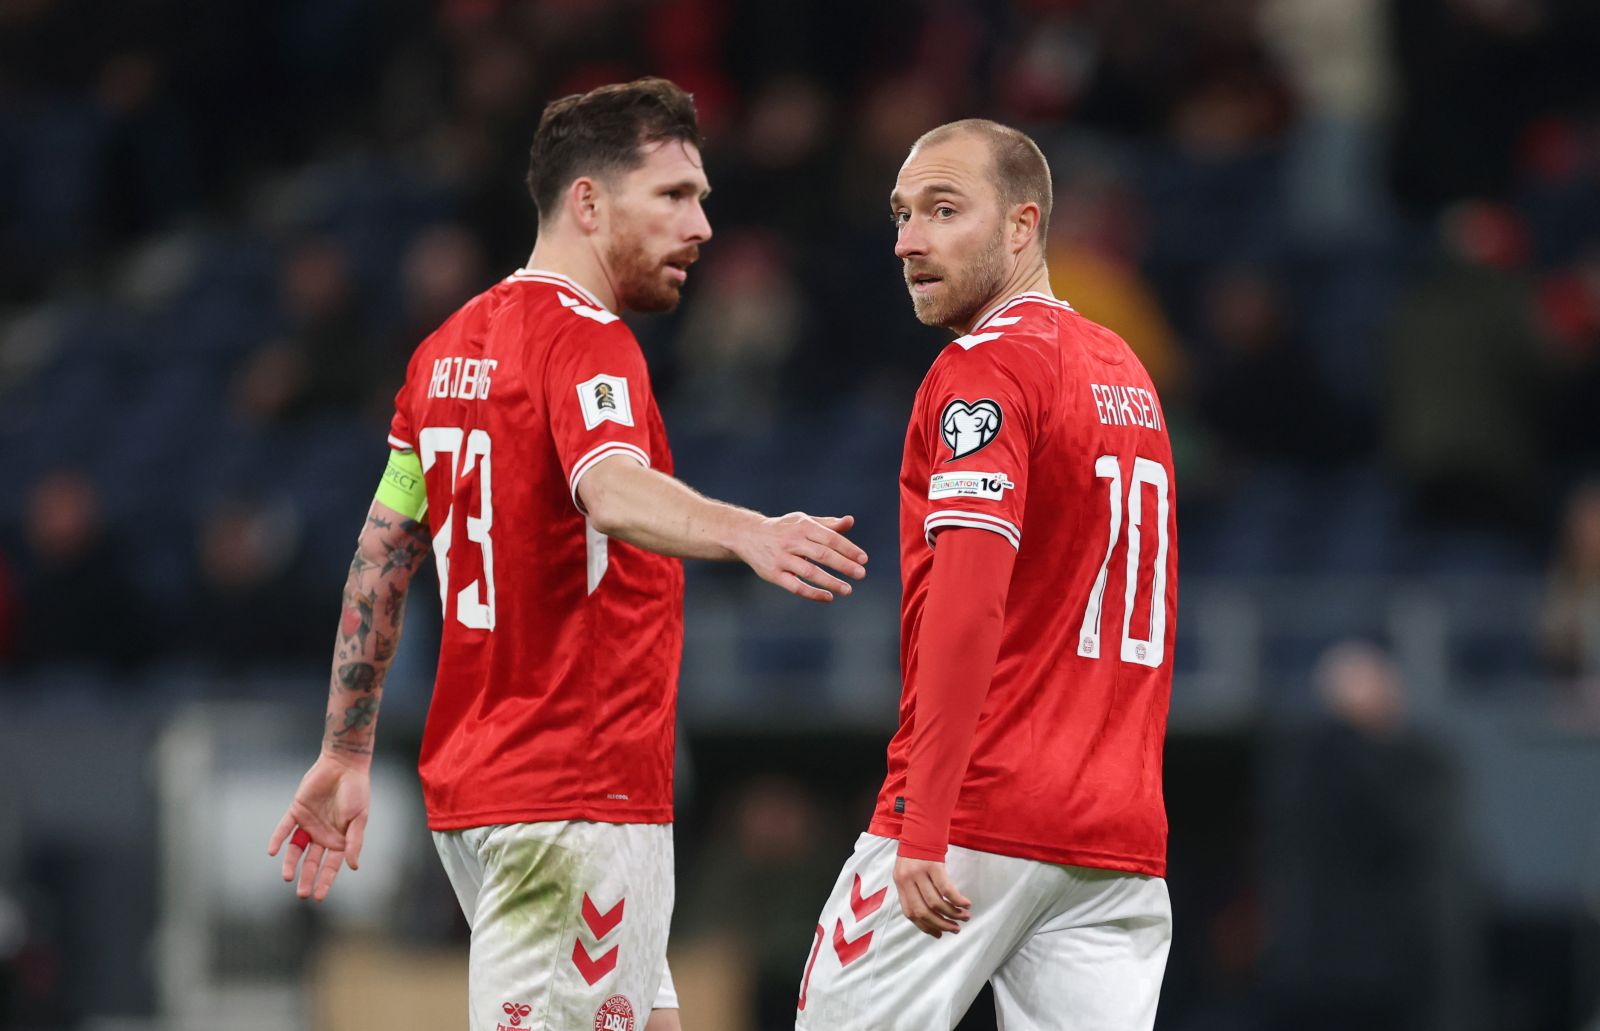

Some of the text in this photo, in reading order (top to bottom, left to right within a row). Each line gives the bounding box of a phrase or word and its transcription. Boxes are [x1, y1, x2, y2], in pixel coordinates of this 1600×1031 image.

[1090, 383, 1161, 432] ERIKSEN
[932, 480, 979, 489] FOUNDATION
[981, 477, 1001, 492] 10
[1077, 454, 1169, 668] 10
[603, 1013, 628, 1031] DBU
